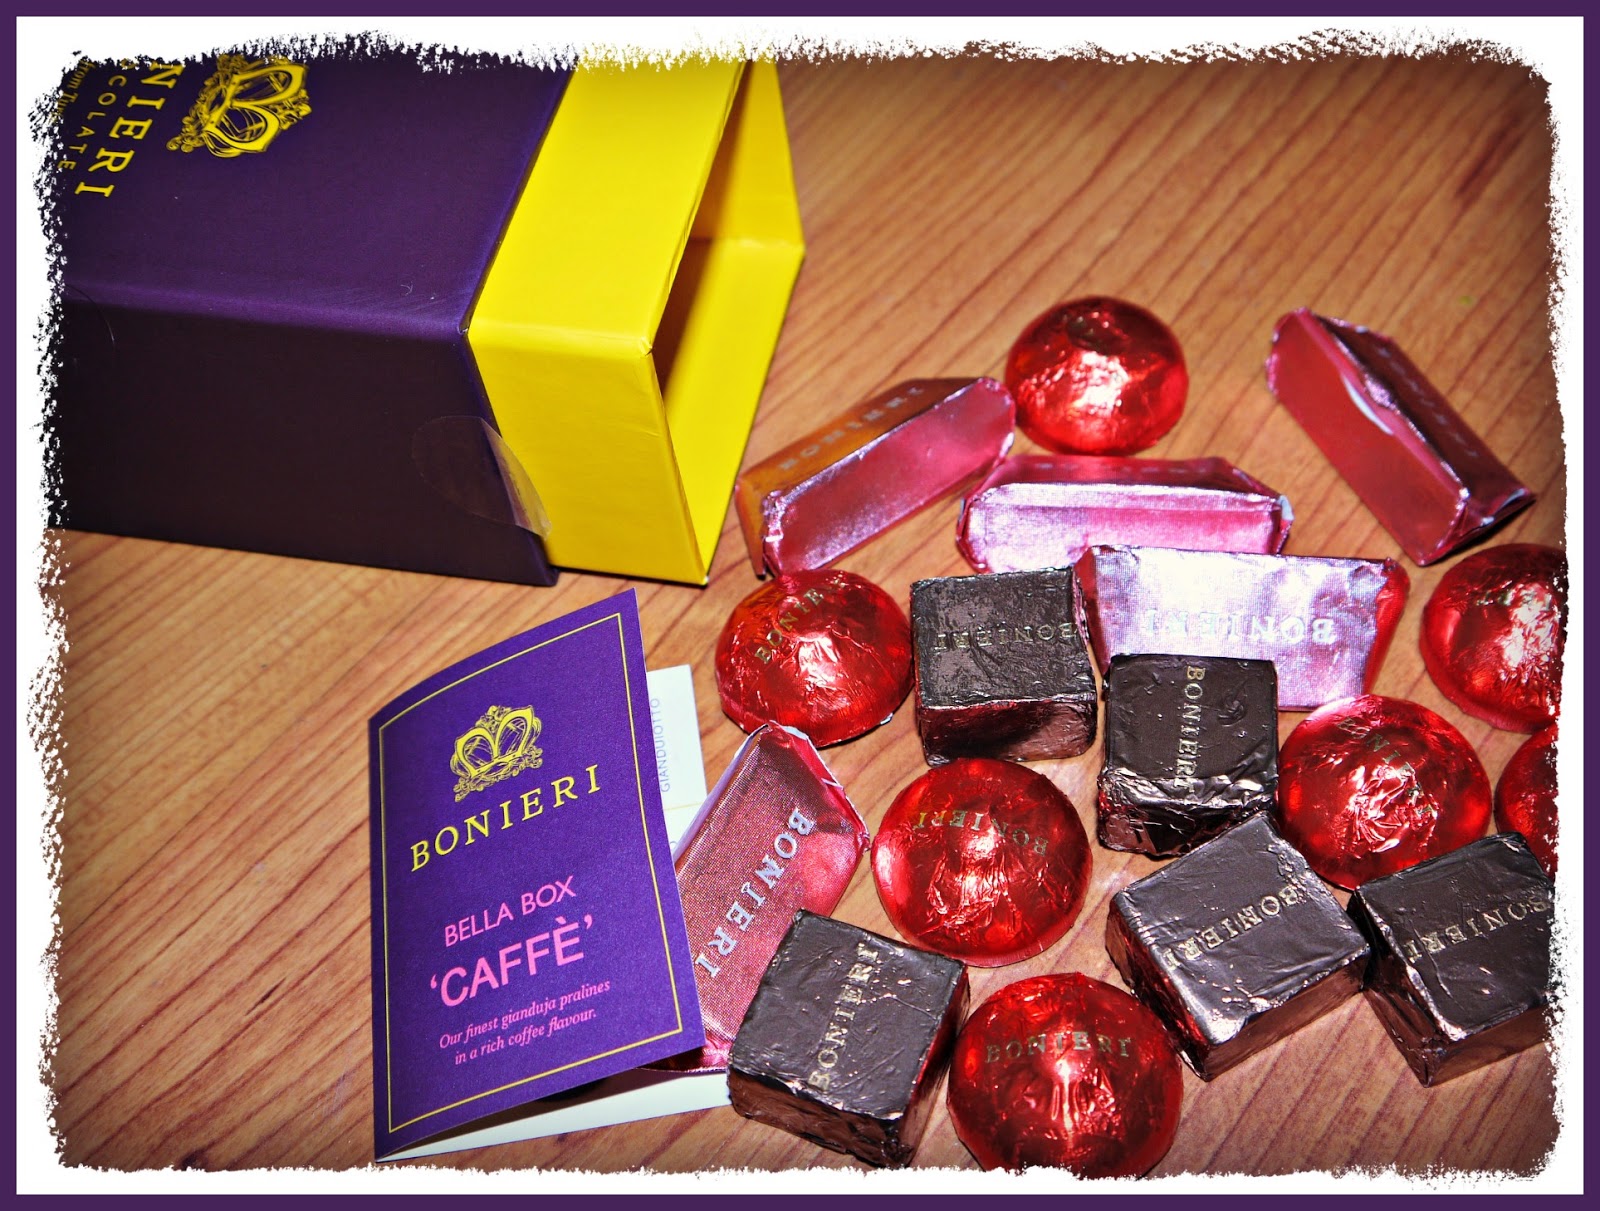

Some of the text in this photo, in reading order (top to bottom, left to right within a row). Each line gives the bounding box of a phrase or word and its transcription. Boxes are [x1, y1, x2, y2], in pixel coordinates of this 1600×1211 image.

[1144, 608, 1337, 645] BONIERI
[650, 698, 670, 793] GIANDUIOTTO
[1174, 665, 1207, 794] BONIERI
[410, 764, 601, 872] BONIERI
[913, 809, 1049, 857] BONIERI
[445, 875, 577, 947] BELLA BOX
[695, 807, 816, 978] BONIERI
[1163, 884, 1306, 971] BONIERI
[440, 980, 610, 1049] Our finest gianduja pralines
[455, 1008, 597, 1065] in a rich coffee flavour.
[808, 942, 879, 1091] BONIERI
[985, 1031, 1131, 1064] BONIERI
